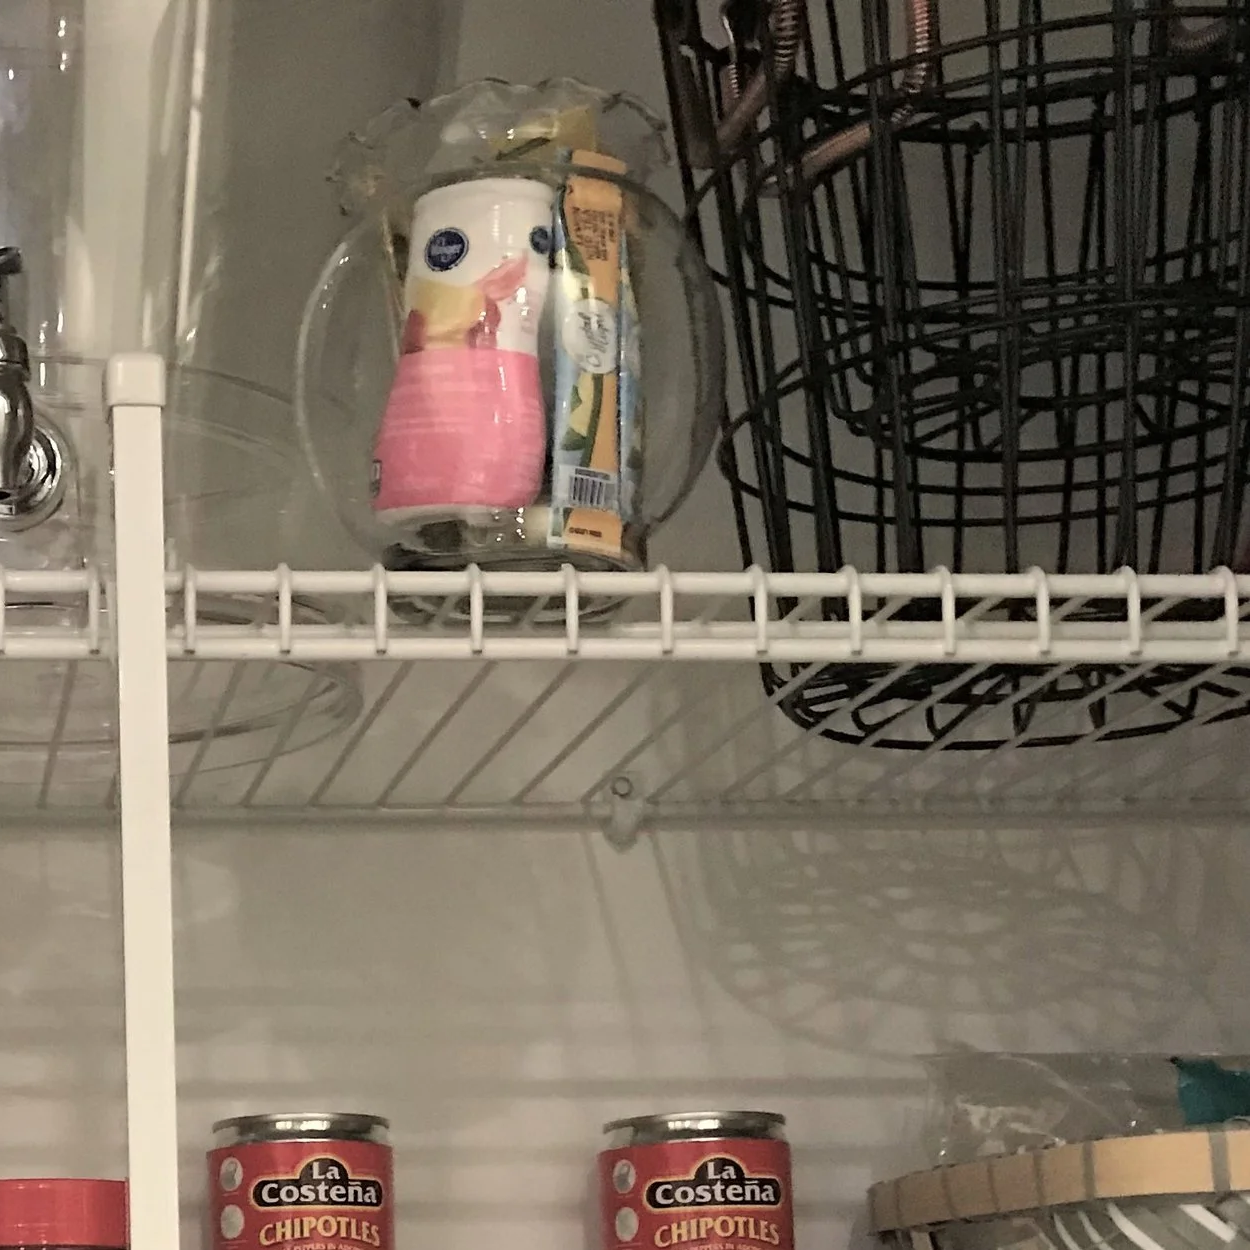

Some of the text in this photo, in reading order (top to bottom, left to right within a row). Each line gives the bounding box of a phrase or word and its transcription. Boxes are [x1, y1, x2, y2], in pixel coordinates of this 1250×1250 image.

[312, 1161, 340, 1180] La
[707, 1161, 736, 1180] La
[261, 1181, 377, 1204] Costeña
[655, 1180, 776, 1205] Costeña
[259, 1215, 380, 1247] CHIPOTLES
[654, 1215, 780, 1248] CHIPOTLES
